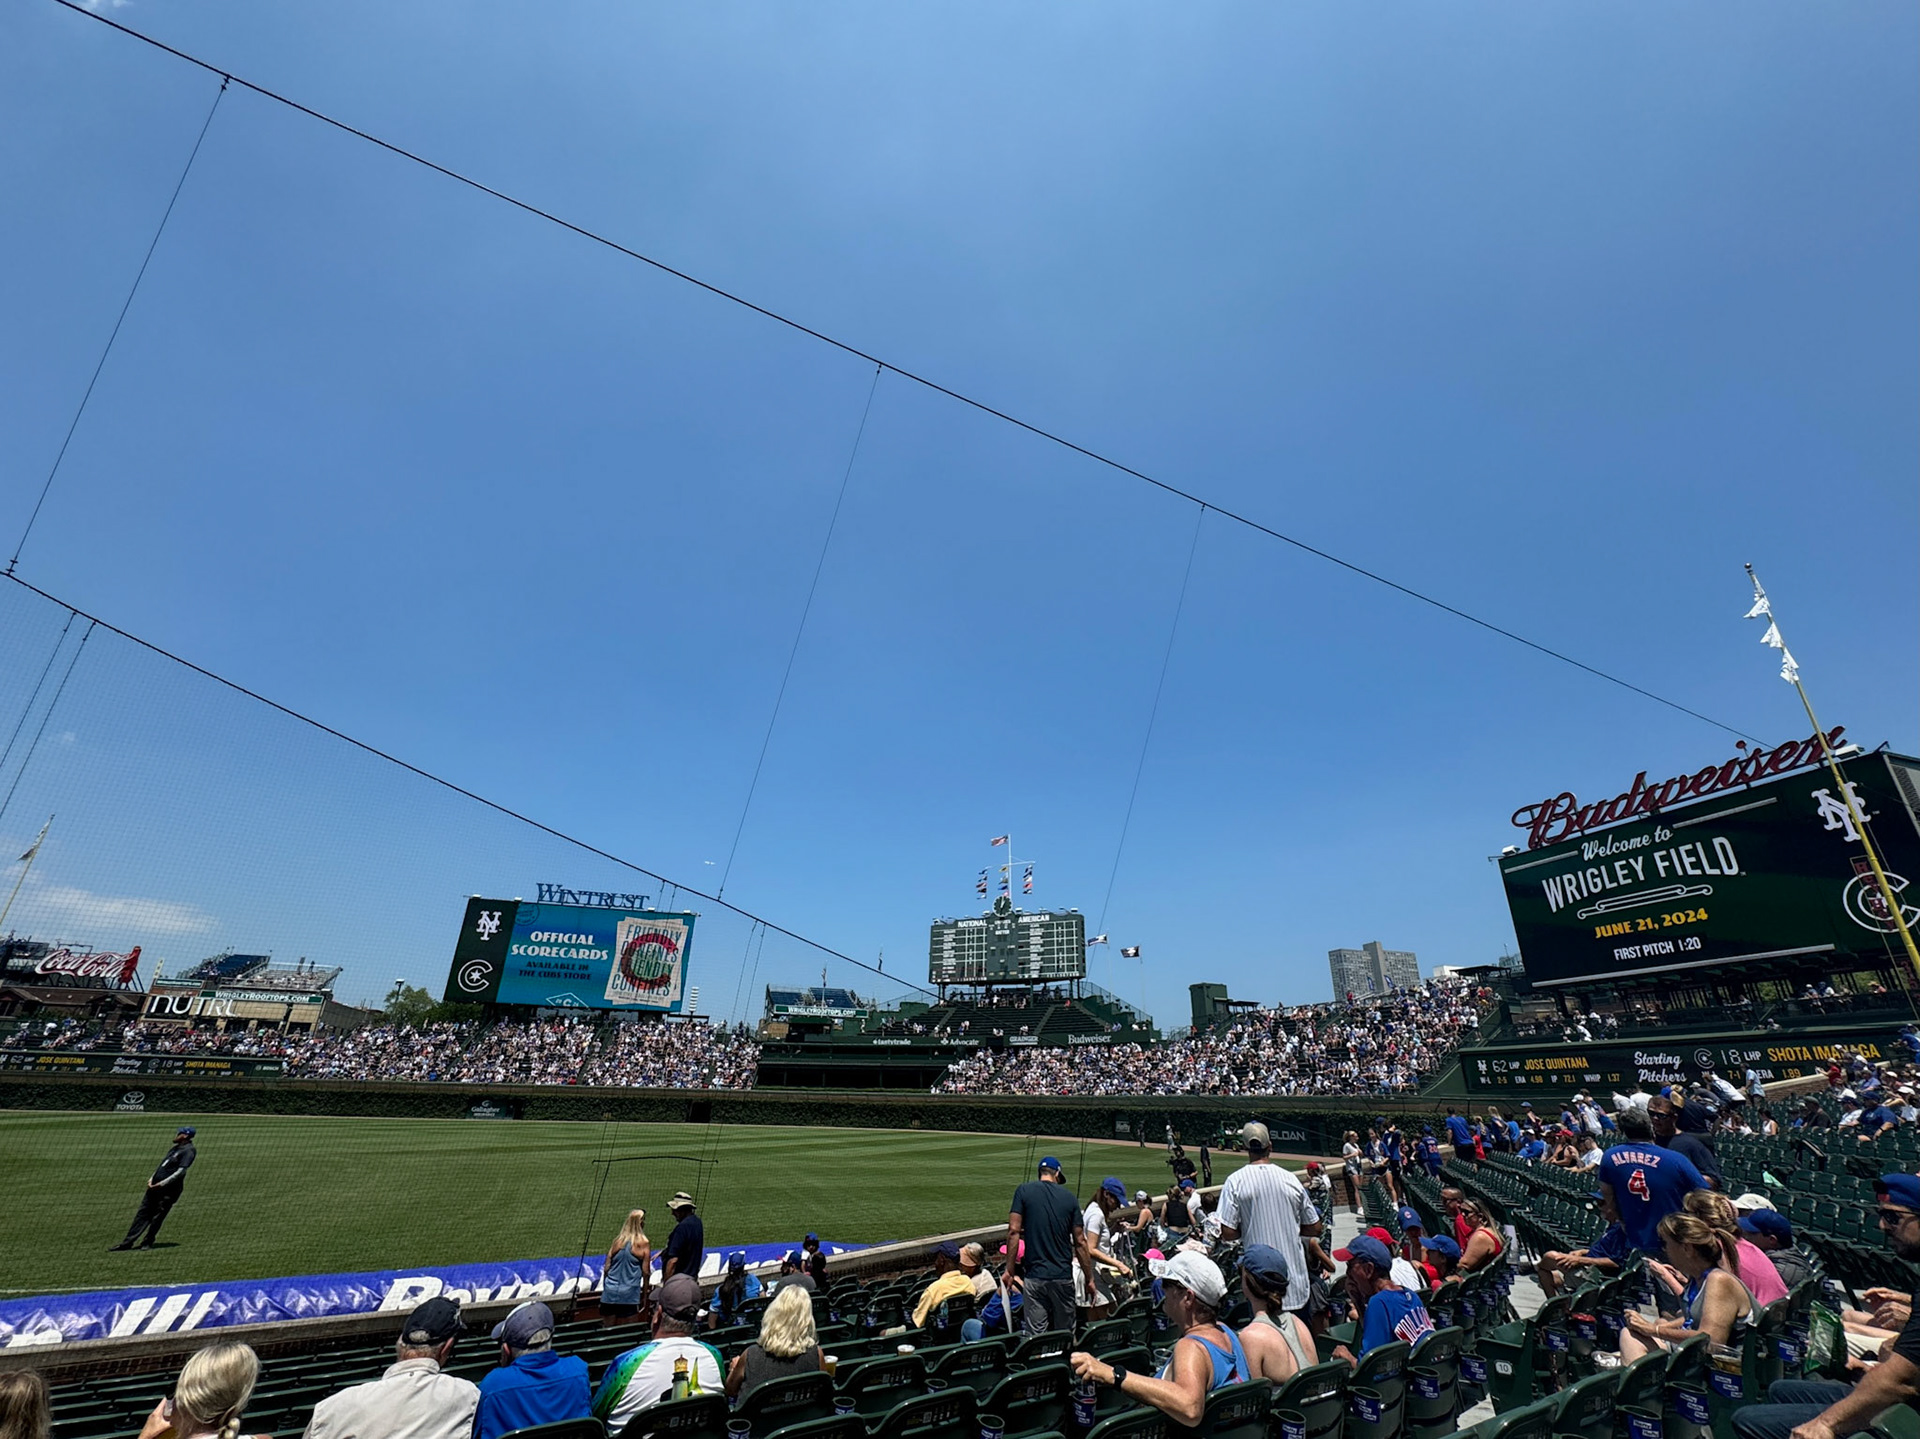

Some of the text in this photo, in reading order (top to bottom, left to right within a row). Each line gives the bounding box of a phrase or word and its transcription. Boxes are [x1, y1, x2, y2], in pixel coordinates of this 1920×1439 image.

[1511, 726, 1847, 849] Budweiser
[1581, 825, 1673, 861] Welcome to
[1541, 836, 1740, 913] WRIGLEY FIELD
[536, 883, 650, 909] WINTRUST
[1017, 914, 1050, 923] AMERICAN
[1594, 907, 1709, 939] JUNE 21, 2024
[530, 930, 595, 946] OFFICIAL
[511, 944, 609, 961] SCORECARDS
[1613, 936, 1702, 961] FIRST PITCH 1:20
[526, 961, 576, 970] AVAILABLE
[538, 970, 561, 979] CUBS
[564, 972, 592, 980] STORE
[1068, 1033, 1112, 1044] Budweiser
[1634, 1051, 1683, 1070] Starting
[1721, 1049, 1741, 1065] 18
[1744, 1050, 1761, 1062] LHP
[1767, 1046, 1811, 1062] SHOTA
[1492, 1060, 1508, 1073] 62
[1509, 1061, 1520, 1069] LHP
[1524, 1058, 1545, 1070] JOSE
[1545, 1056, 1590, 1070] QUINTANA
[1515, 1075, 1526, 1083] ERA
[1550, 1075, 1558, 1083] IP
[1583, 1074, 1601, 1082] WHIP
[1607, 1073, 1621, 1082] 1.37
[1638, 1067, 1688, 1083] Pitchers
[1727, 1068, 1802, 1080] 7-1 ERA 1.89
[1270, 1130, 1305, 1141] SLOAN
[1611, 1151, 1661, 1168] ALVAREZ
[1627, 1169, 1651, 1201] 4
[1499, 1364, 1509, 1372] 10
